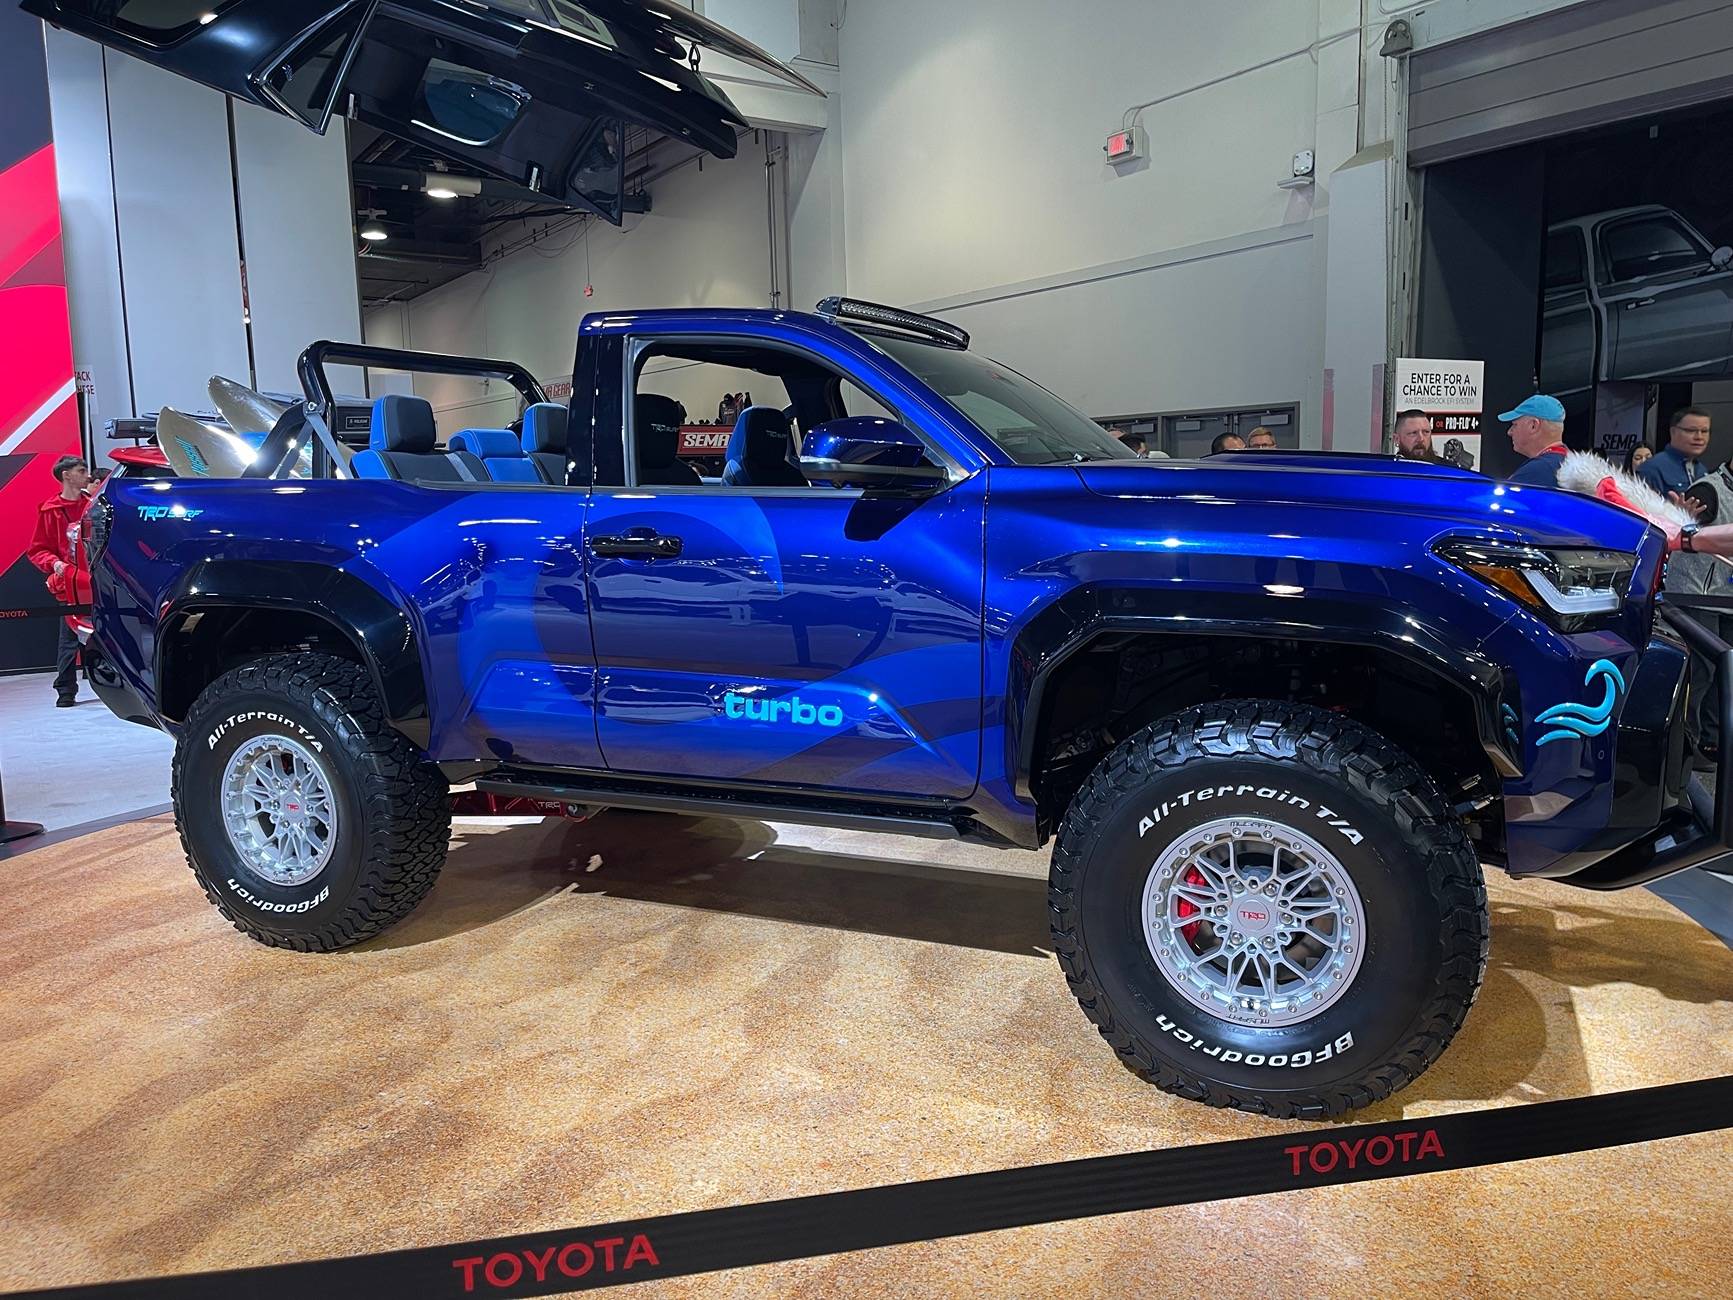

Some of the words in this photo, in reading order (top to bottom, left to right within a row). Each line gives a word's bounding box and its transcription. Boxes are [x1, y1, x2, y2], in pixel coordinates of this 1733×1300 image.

[75, 371, 91, 381] ACK
[1402, 385, 1442, 396] CHANCE
[1444, 386, 1457, 396] TO
[1459, 386, 1477, 397] WIN
[1411, 373, 1441, 384] ENTER
[1443, 373, 1462, 385] FOR
[1464, 374, 1471, 385] A
[683, 434, 730, 448] SEMA
[137, 505, 169, 521] TRD
[723, 691, 844, 727] turbo
[207, 711, 295, 750] All-Terrain
[298, 724, 324, 753] T/A
[1138, 784, 1310, 838] All-Terrain
[1315, 805, 1364, 846] T/A
[227, 878, 330, 913] BFGoodrich
[1155, 1014, 1354, 1068] BFGoodrich
[1284, 1130, 1445, 1175] TOYOTA
[452, 1234, 660, 1291] TOYOTA
